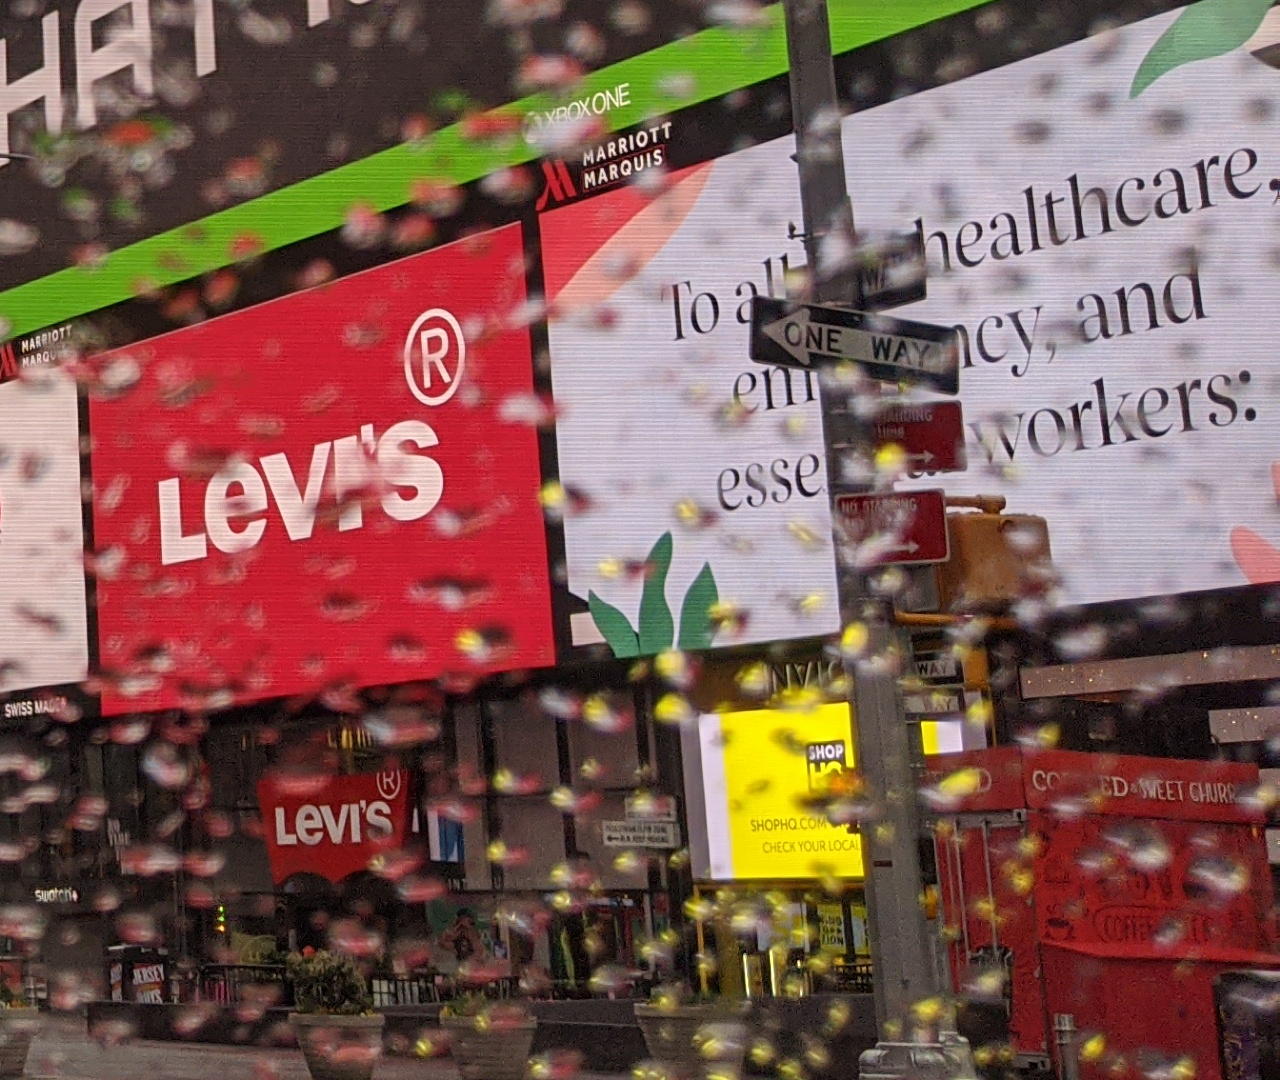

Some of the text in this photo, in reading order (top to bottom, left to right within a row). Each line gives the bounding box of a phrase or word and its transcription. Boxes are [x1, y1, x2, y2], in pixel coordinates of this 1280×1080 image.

[591, 82, 632, 115] ONE
[582, 121, 673, 168] MARRIOTT
[583, 148, 664, 190] MARQUIS
[671, 281, 720, 342] To
[1075, 267, 1210, 344] and
[21, 323, 73, 354] MARRIOTT
[783, 320, 931, 368] ONE WAY
[970, 368, 1258, 463] workers:
[917, 661, 950, 677] WAY
[4, 700, 33, 718] SWISS
[808, 743, 844, 760] SHOP
[1139, 778, 1187, 802] SWEET
[749, 818, 827, 833] SHOPHQ.COM
[762, 840, 797, 854] CHECK
[798, 839, 827, 853] YOUR
